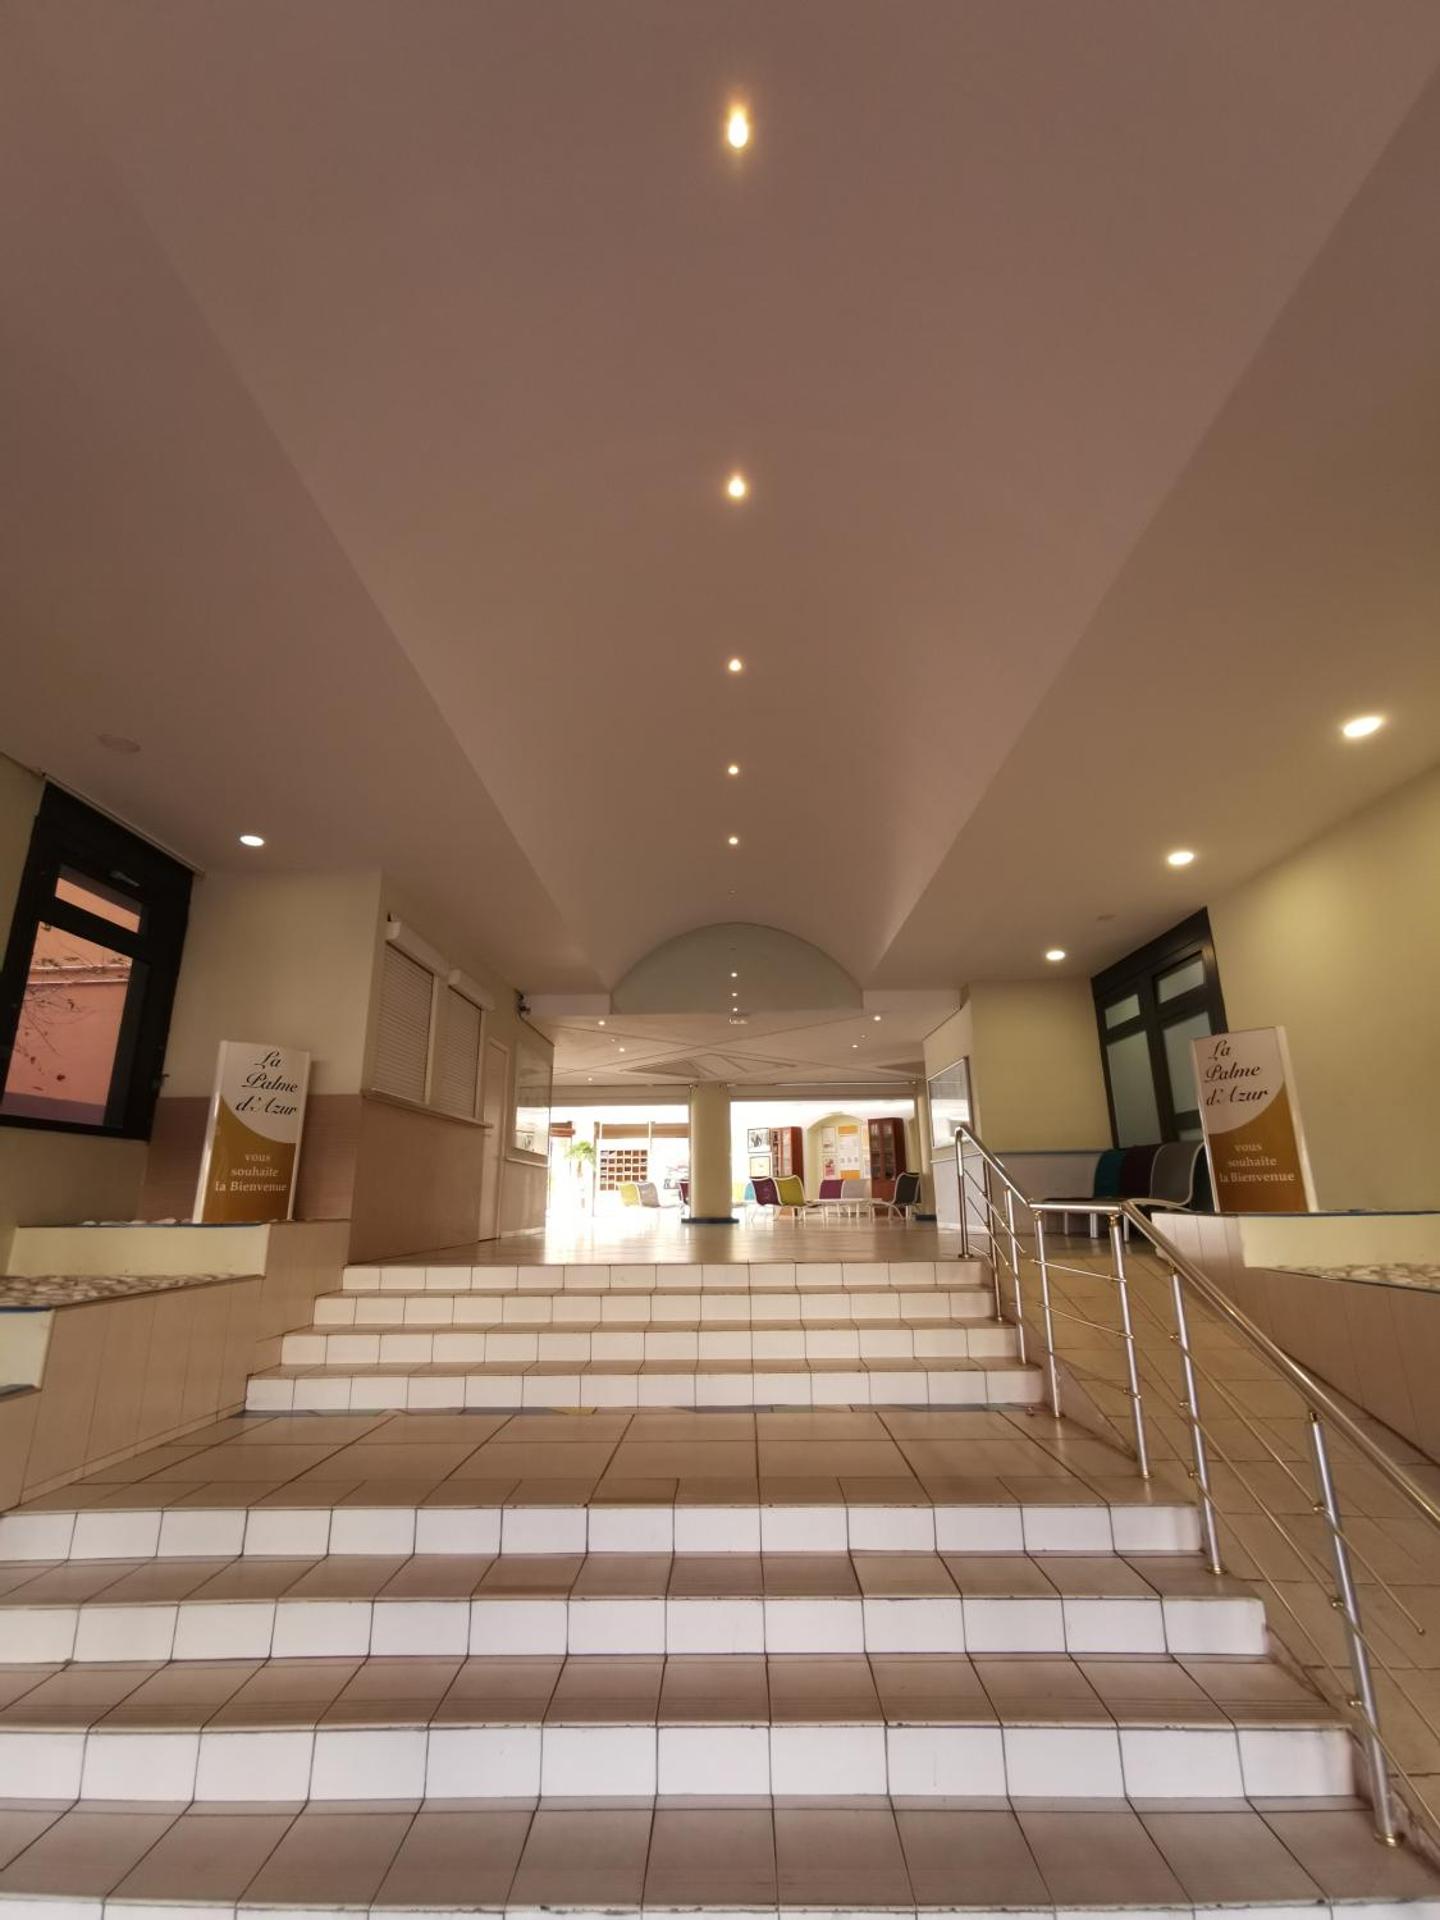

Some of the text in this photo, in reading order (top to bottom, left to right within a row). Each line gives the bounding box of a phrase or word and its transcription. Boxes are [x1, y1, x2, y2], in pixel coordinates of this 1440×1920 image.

[1208, 1039, 1232, 1060] La
[254, 1050, 282, 1069] La
[1204, 1061, 1261, 1082] Palme
[241, 1072, 298, 1093] Palme
[1206, 1086, 1268, 1106] d'Azur
[235, 1095, 298, 1116] d'Azur
[1234, 1144, 1263, 1152] vous
[244, 1153, 271, 1162] vous
[1228, 1155, 1278, 1167] souhaite
[231, 1166, 280, 1177] souhaite
[1219, 1172, 1296, 1183] la Bienvenue
[214, 1181, 288, 1192] la Bienvenue
